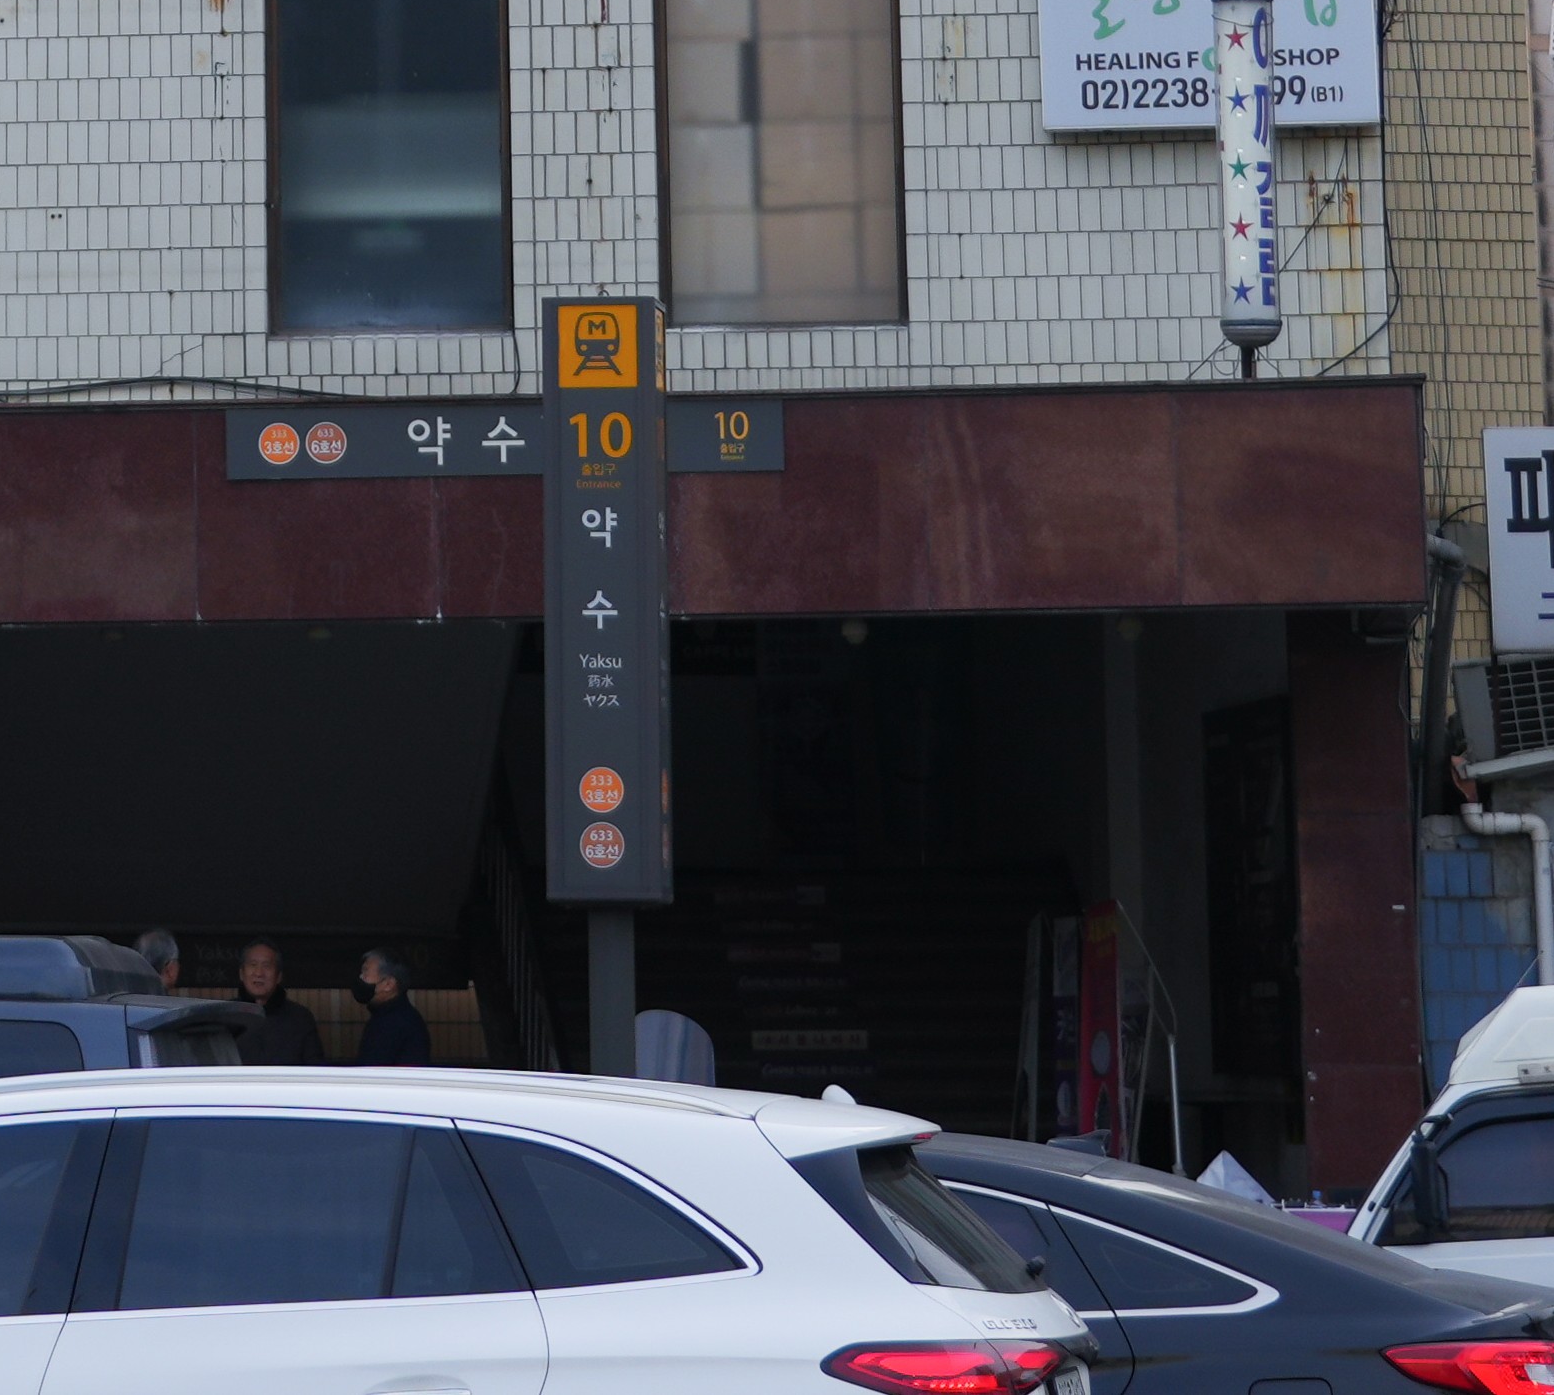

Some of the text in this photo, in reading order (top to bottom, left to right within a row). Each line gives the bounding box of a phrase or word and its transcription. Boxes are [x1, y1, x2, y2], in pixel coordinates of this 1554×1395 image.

[1075, 51, 1181, 73] HEALING
[1273, 48, 1341, 69] SHOP
[1310, 85, 1345, 104] (B1)
[714, 411, 749, 439] 10
[408, 416, 526, 466] 약수
[569, 411, 633, 458] 10
[264, 441, 295, 454] 3호선
[311, 440, 342, 453] 6호선
[582, 463, 616, 476] 출입구
[576, 479, 622, 490] Entrance
[581, 506, 619, 631] 약수
[579, 652, 622, 669] Yaksu
[583, 693, 620, 707] ヤクス
[590, 775, 613, 786] 333
[586, 789, 619, 804] 3호선
[590, 830, 613, 841] 633
[585, 844, 620, 859] 6호선
